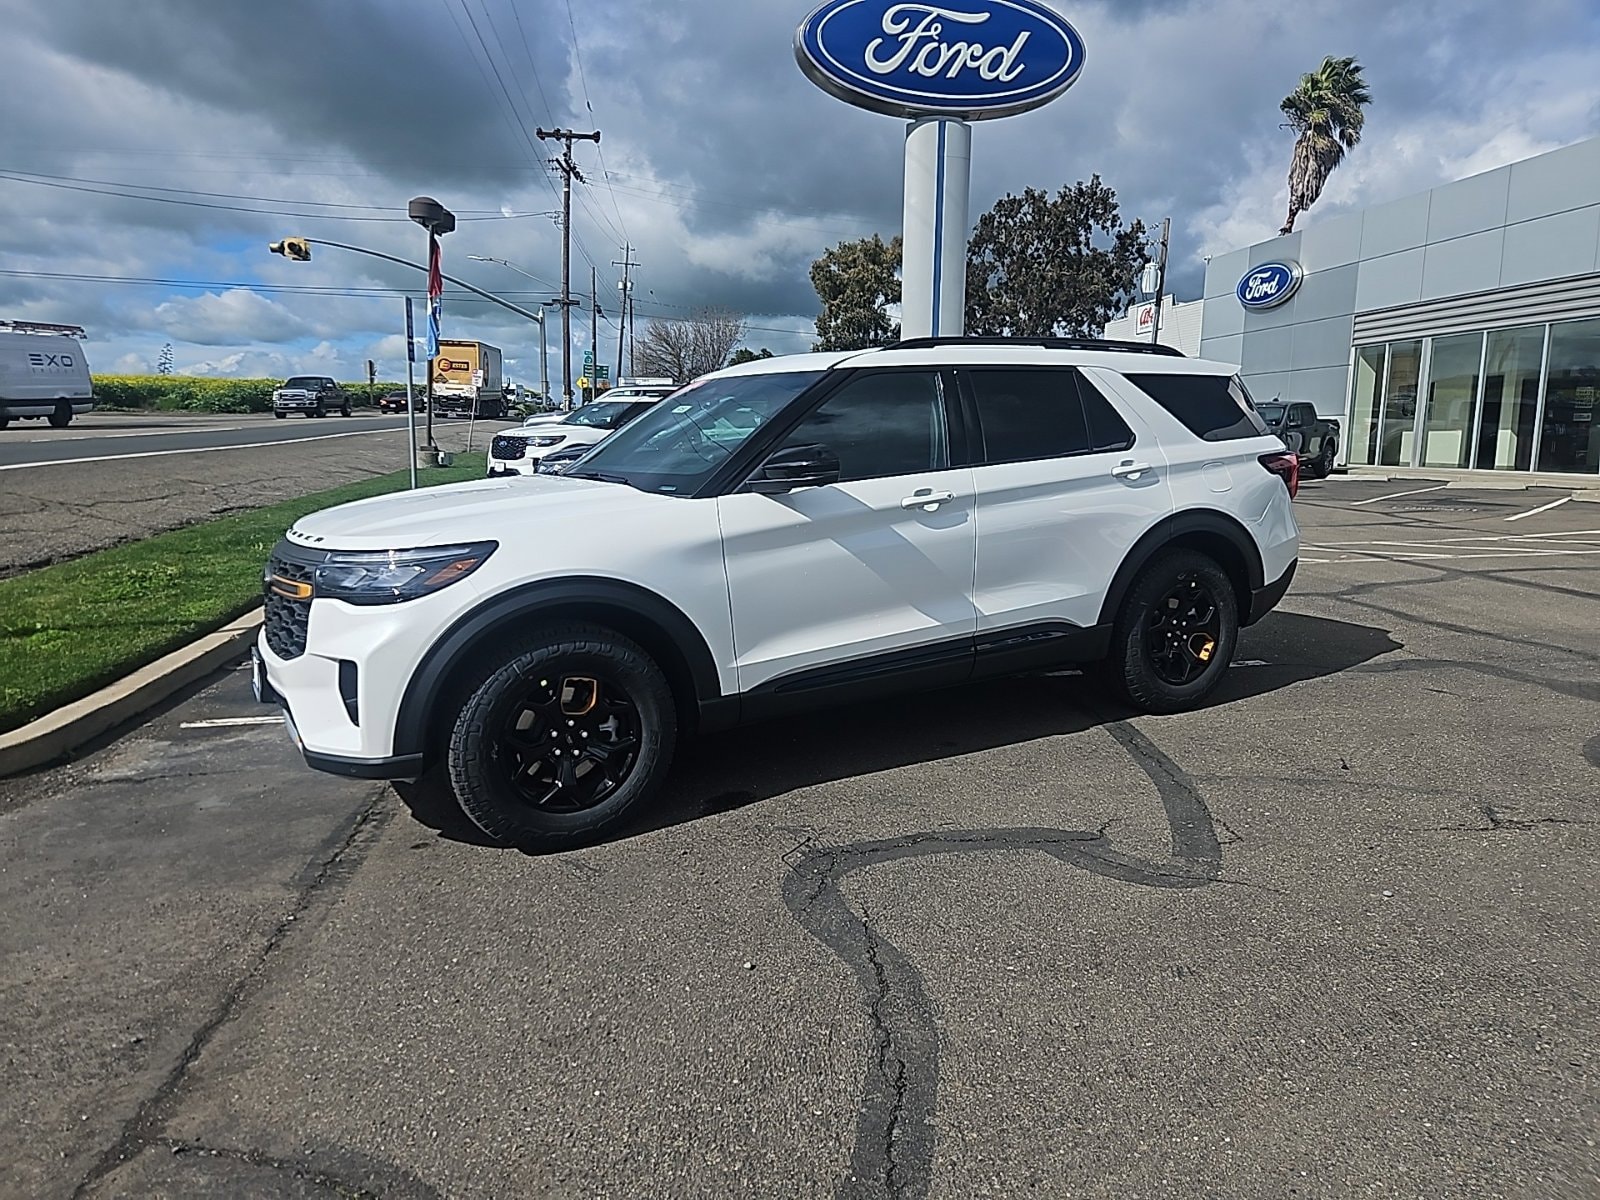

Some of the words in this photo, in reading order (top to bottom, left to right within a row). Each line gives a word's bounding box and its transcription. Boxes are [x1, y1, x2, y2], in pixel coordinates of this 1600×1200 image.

[865, 3, 1031, 82] Ford
[1245, 270, 1280, 300] Ford
[29, 353, 73, 367] EXO
